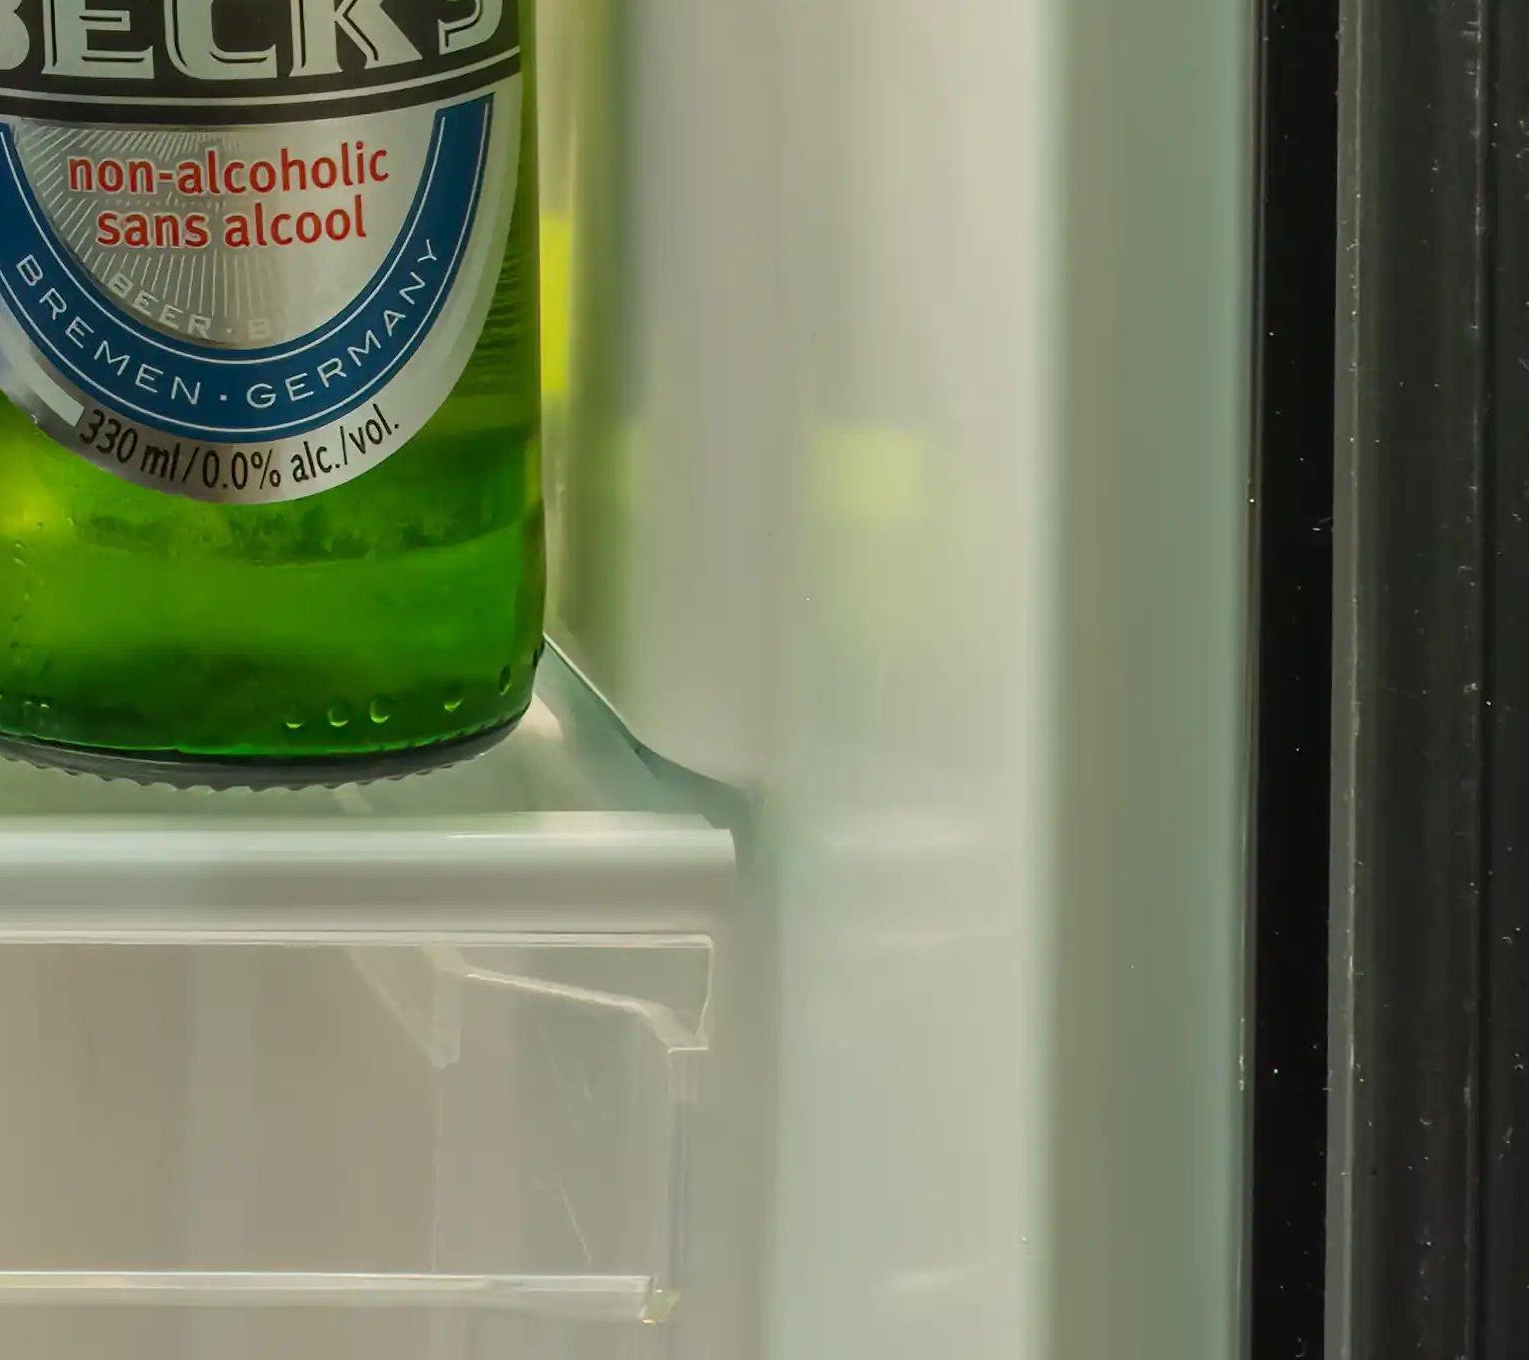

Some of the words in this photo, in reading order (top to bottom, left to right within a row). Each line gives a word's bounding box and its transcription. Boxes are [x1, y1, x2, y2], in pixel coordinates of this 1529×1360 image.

[68, 140, 391, 200] non-alcoholic
[97, 209, 211, 249] sans
[223, 194, 367, 248] alcool
[15, 255, 202, 406] BREMEN
[245, 239, 440, 410] GERMANY
[108, 273, 213, 342] BEER
[79, 408, 138, 465] 330
[290, 403, 399, 484] alc./vol.
